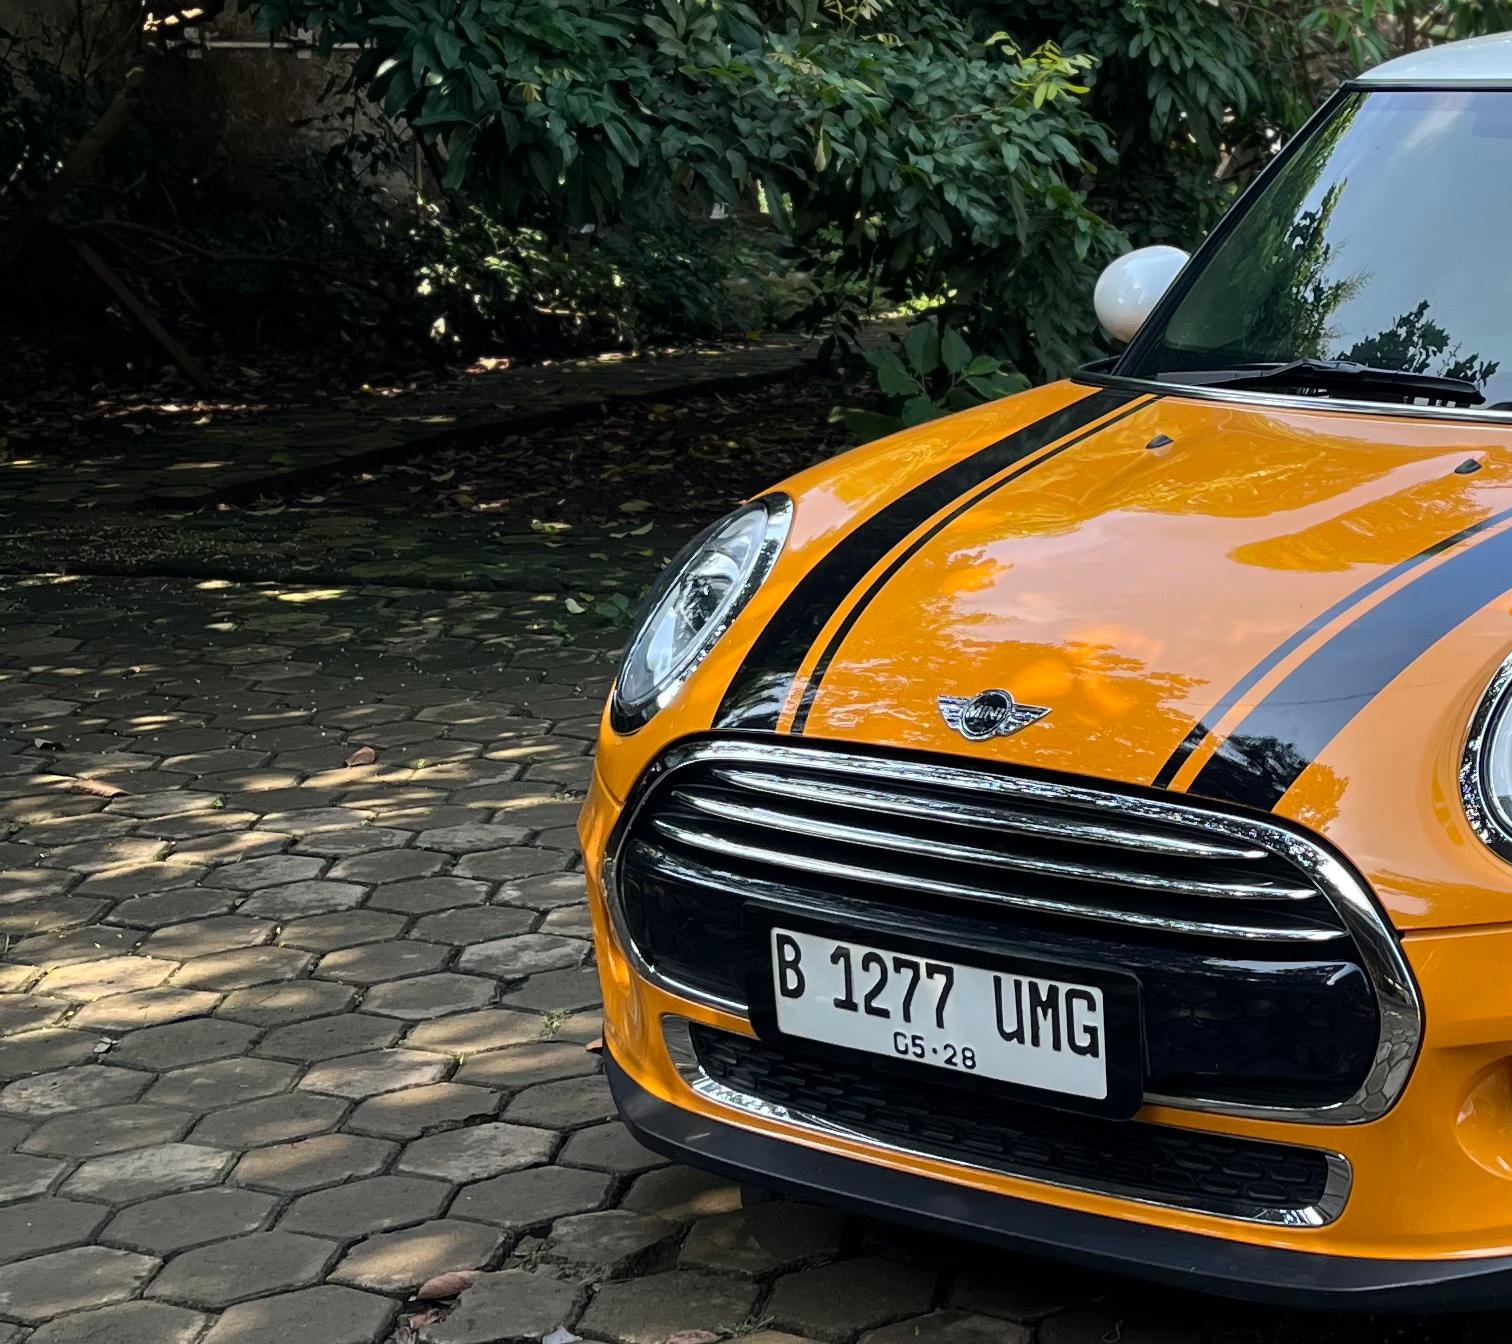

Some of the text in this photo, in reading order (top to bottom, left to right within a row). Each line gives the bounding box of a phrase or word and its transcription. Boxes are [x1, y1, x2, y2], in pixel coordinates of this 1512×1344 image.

[967, 704, 1006, 721] MINI
[776, 933, 1099, 1058] B 1277 UMG
